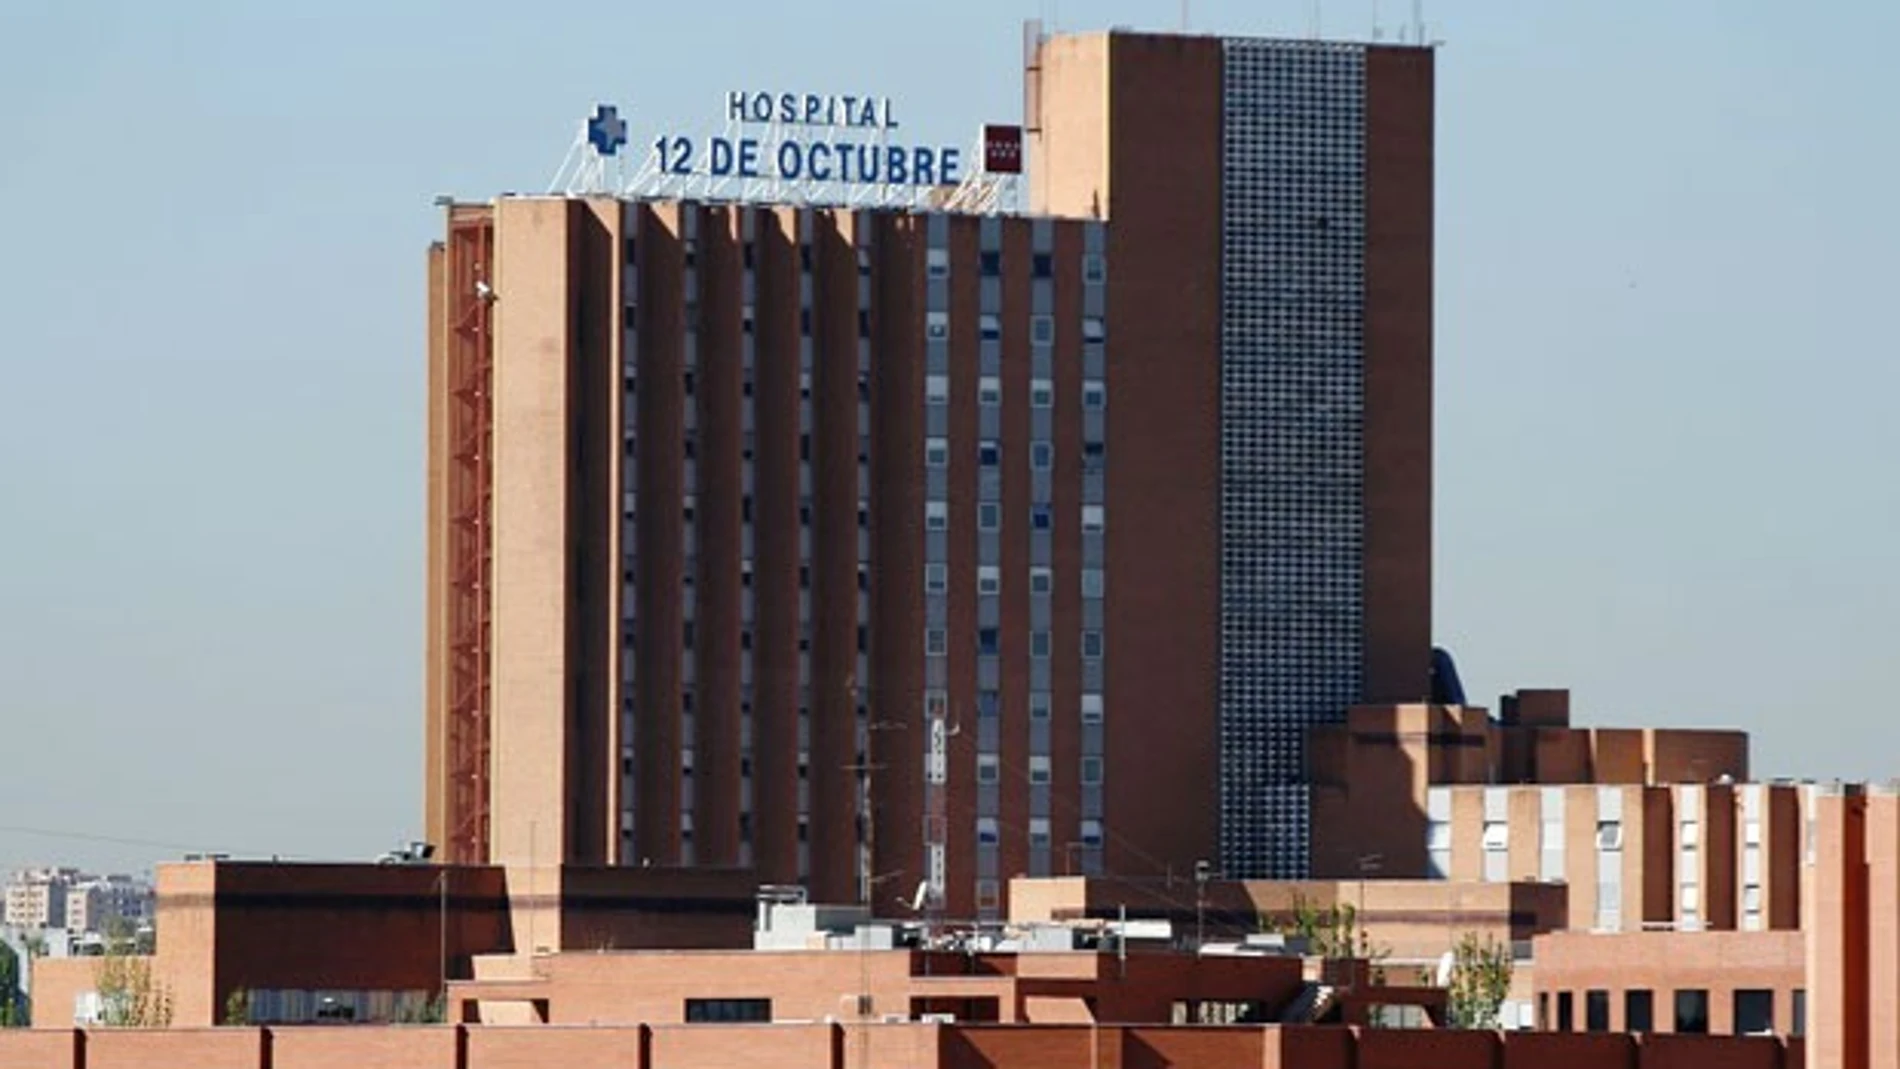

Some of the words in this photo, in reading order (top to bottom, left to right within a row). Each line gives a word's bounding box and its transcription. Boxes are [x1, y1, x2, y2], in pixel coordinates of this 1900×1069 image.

[729, 91, 899, 128] HOSPITAL
[655, 136, 693, 174] 12
[710, 138, 759, 178] DE
[777, 140, 960, 185] OCTUBRE
